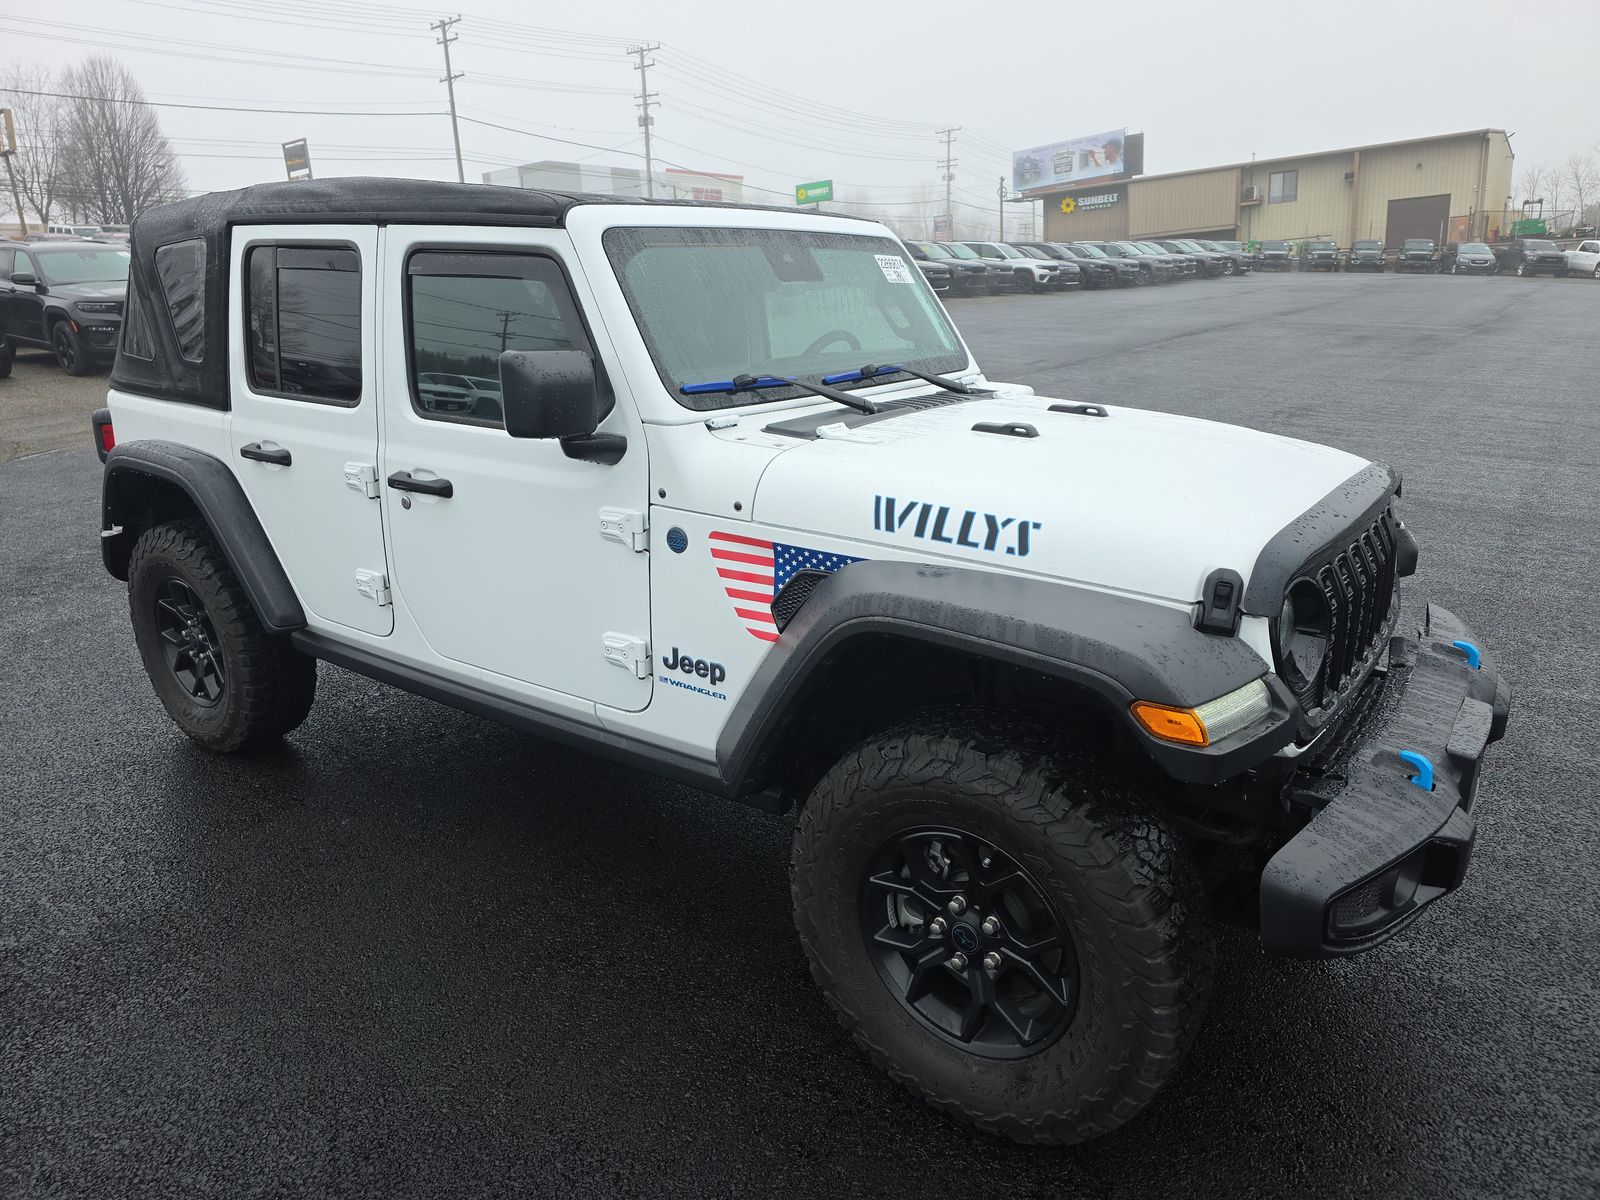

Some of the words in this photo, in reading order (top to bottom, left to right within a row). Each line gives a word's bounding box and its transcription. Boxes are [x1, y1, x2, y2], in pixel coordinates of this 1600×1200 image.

[1078, 193, 1119, 206] SUNBELT
[873, 494, 1042, 557] WILLYS
[662, 646, 726, 686] Jeep
[668, 678, 727, 701] WRANGLER
